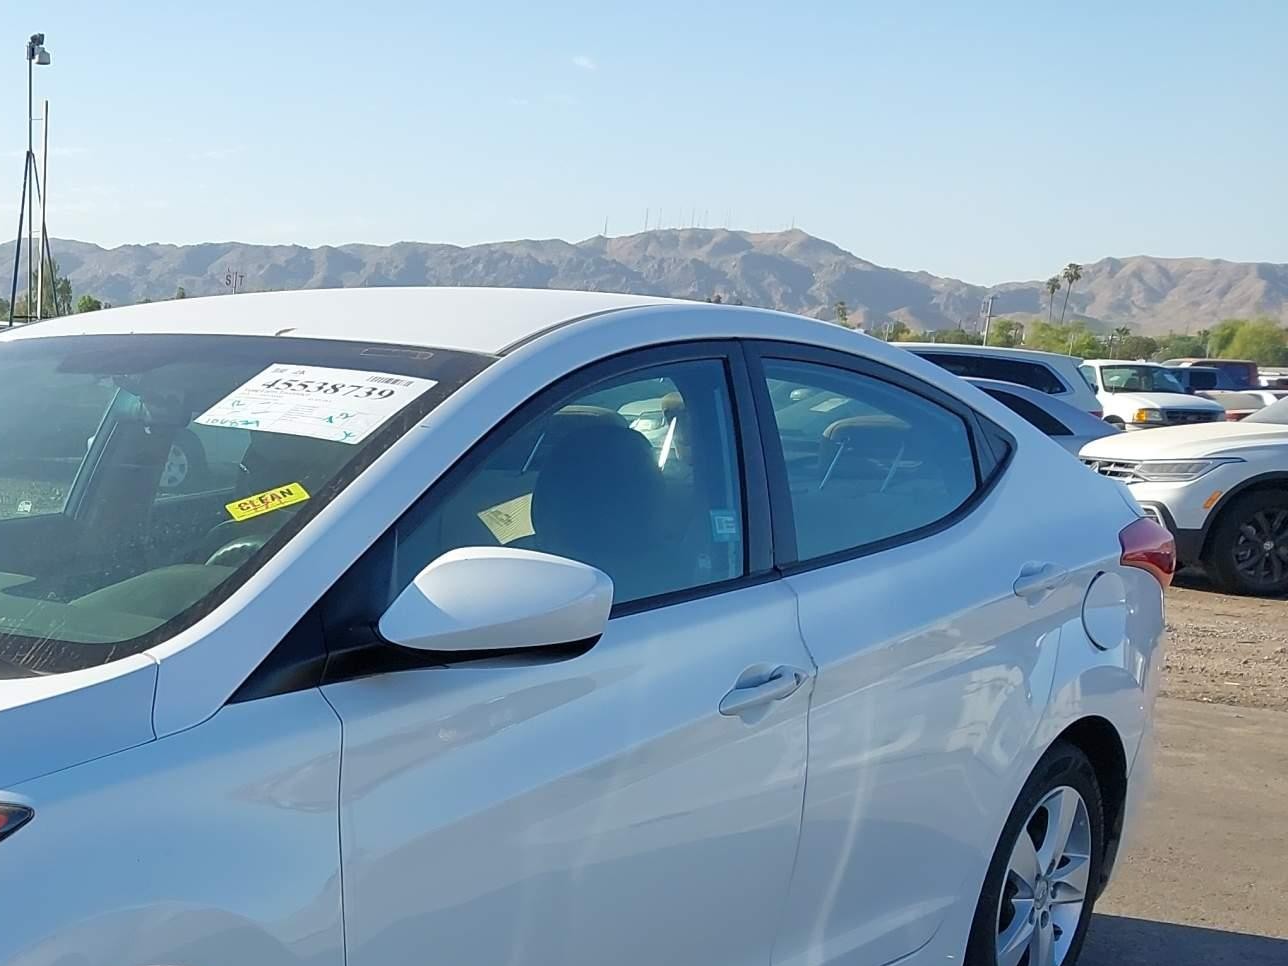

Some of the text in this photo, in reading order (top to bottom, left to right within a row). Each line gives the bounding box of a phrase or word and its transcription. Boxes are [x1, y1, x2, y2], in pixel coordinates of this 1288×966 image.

[225, 274, 232, 286] S
[261, 378, 395, 400] 45538739
[237, 488, 294, 511] CLEAN
